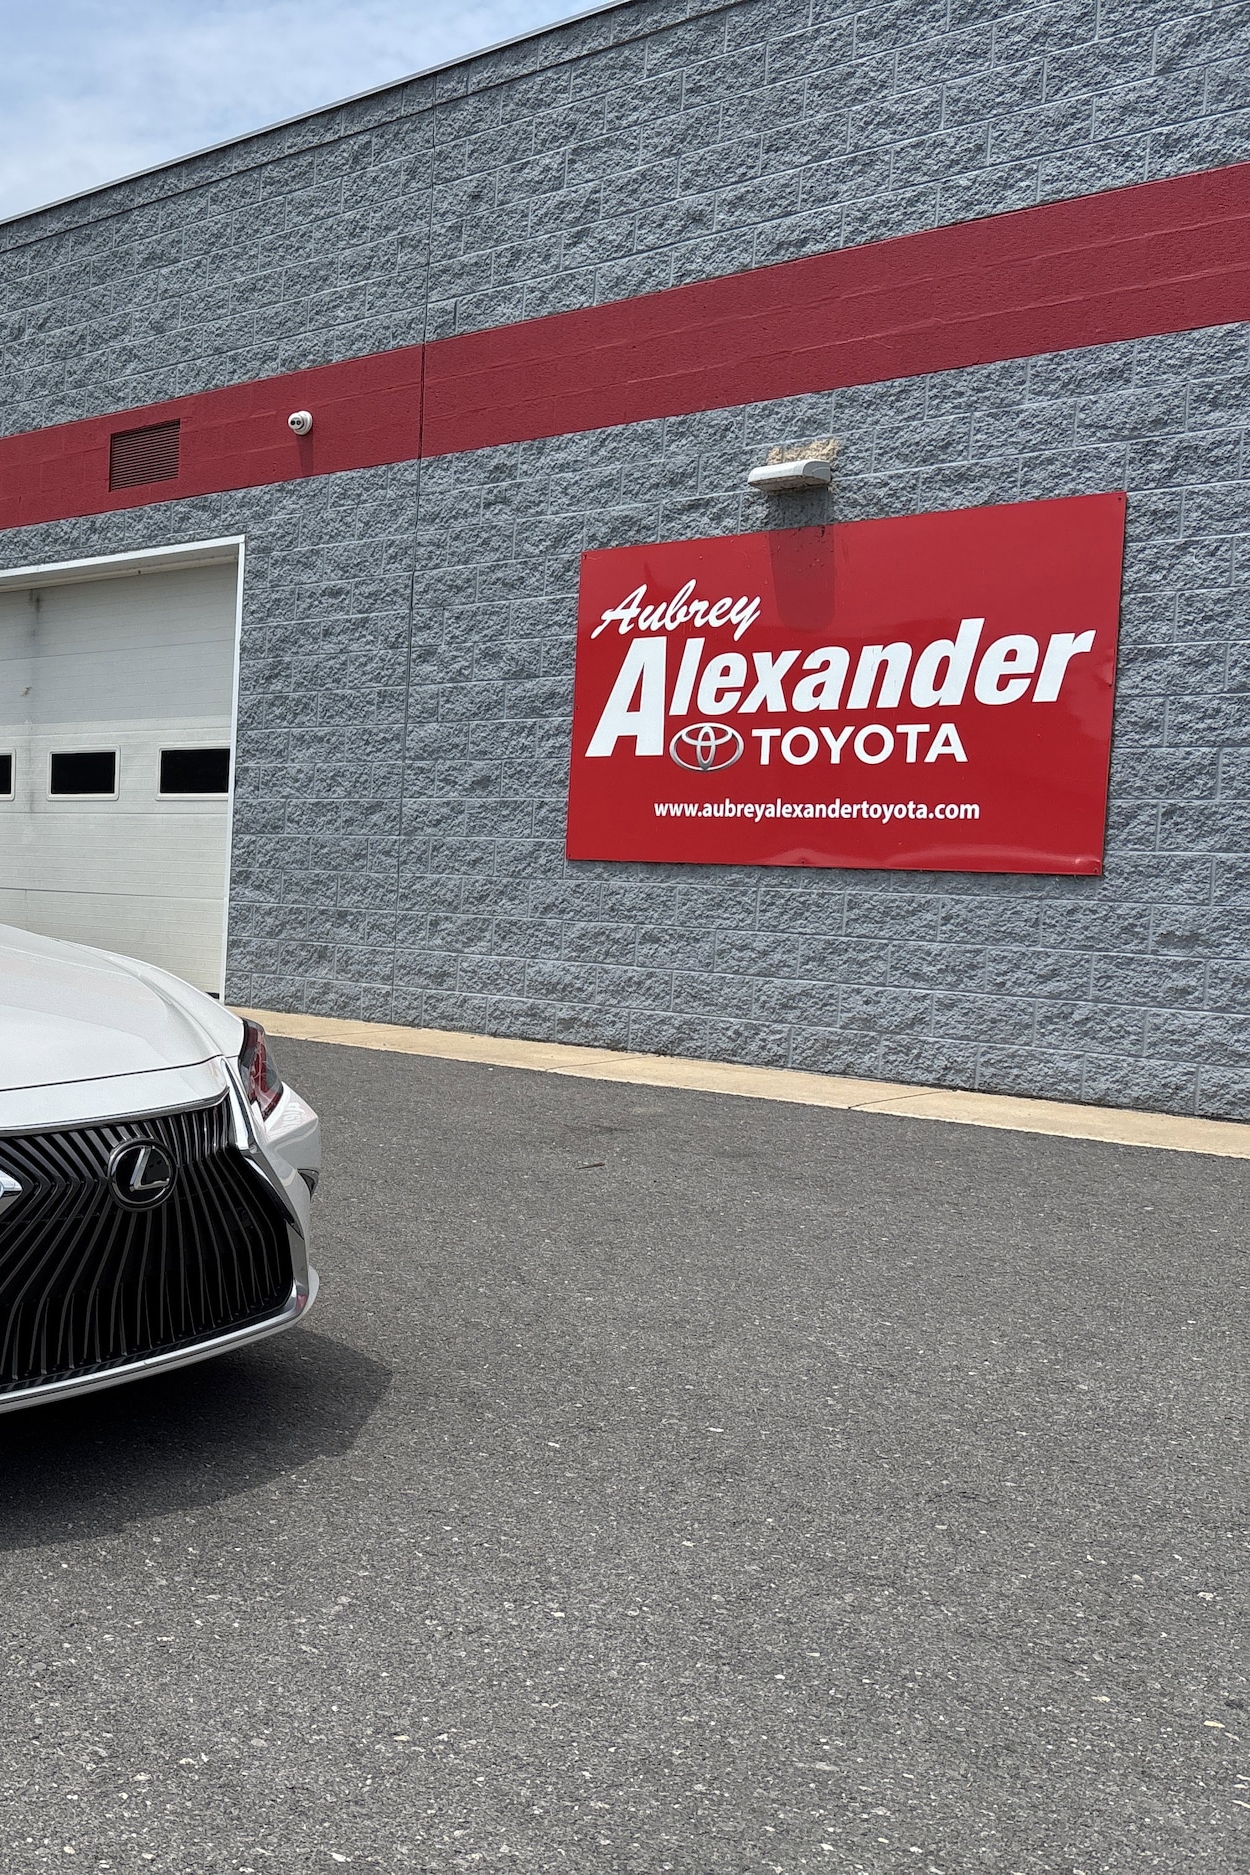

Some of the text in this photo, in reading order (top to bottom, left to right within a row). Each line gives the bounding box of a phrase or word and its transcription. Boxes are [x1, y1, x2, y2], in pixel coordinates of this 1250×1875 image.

[591, 578, 761, 641] Aubrey
[585, 618, 1096, 757] Alexander
[752, 722, 968, 765] TOYOTA
[654, 798, 980, 823] www.aubreyalexandertoyota.com
